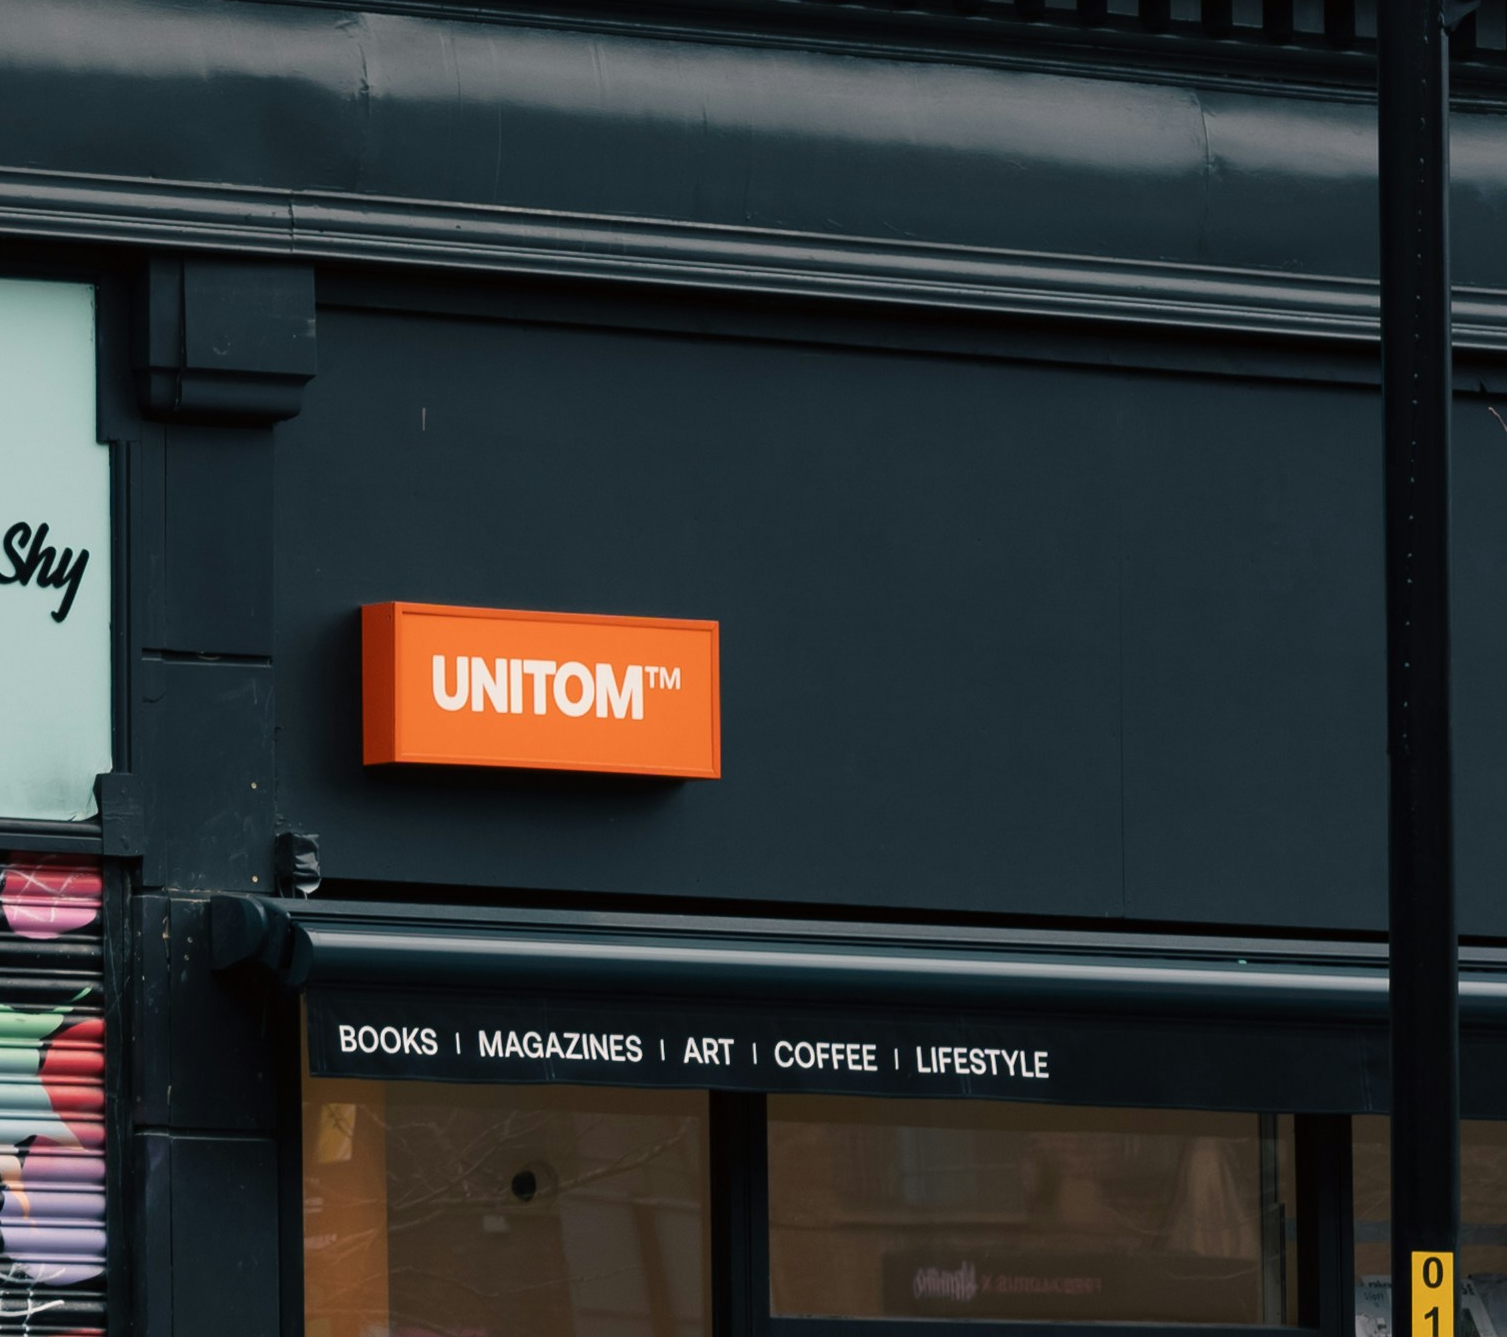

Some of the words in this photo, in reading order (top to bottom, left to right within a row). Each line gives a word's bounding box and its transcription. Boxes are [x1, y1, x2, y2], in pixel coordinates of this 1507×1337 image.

[338, 1023, 439, 1056] BOOKS
[477, 1029, 643, 1063] MAGAZINES
[683, 1036, 735, 1066] ART
[773, 1040, 878, 1072] COFFEE
[915, 1045, 1050, 1079] LIFESTYLE
